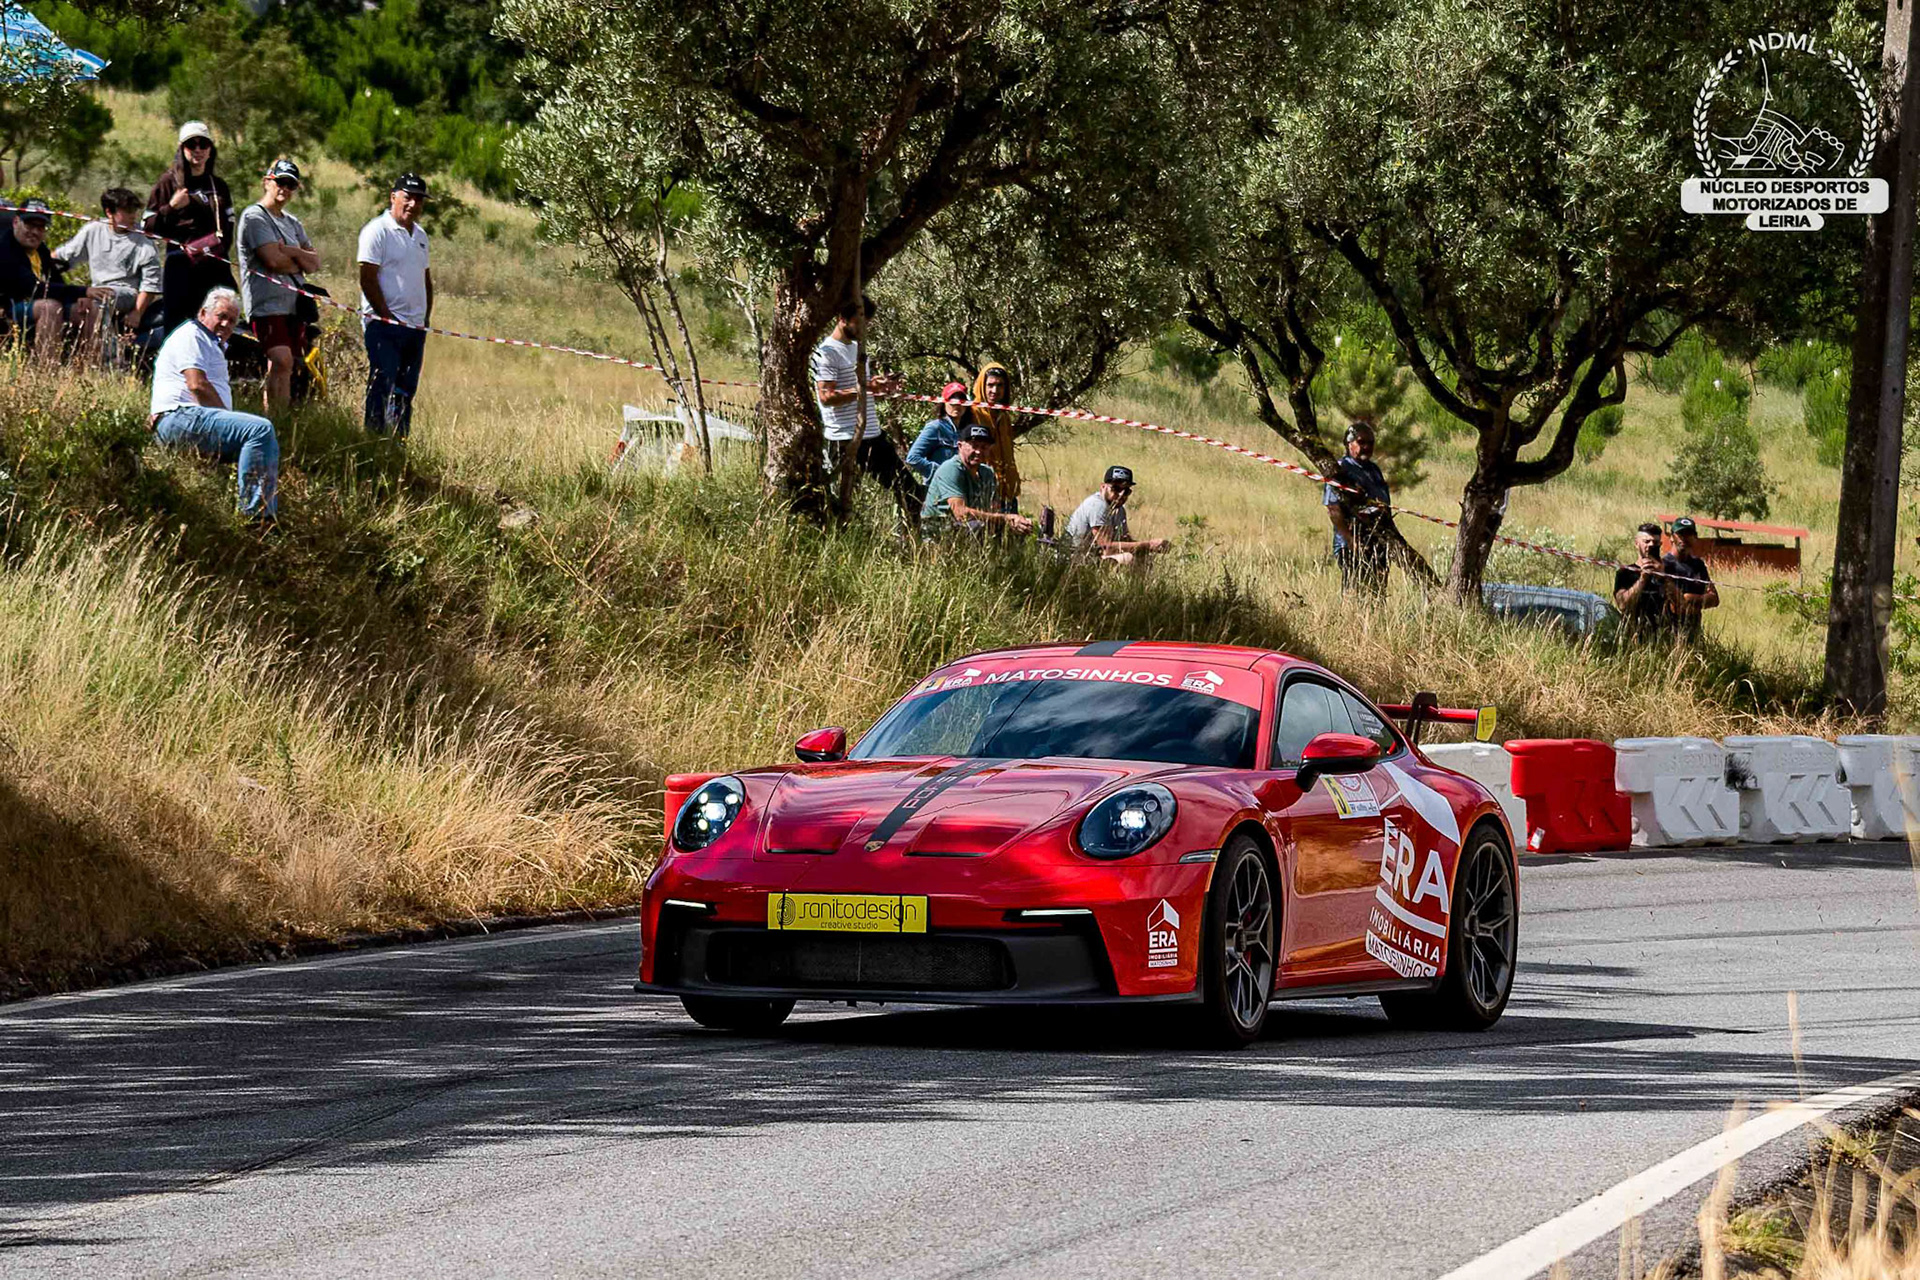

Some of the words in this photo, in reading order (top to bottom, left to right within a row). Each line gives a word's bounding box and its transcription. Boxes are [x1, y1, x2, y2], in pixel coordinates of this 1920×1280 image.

[983, 668, 1173, 686] MATOSINHOS
[1180, 678, 1215, 691] ERA
[1380, 820, 1449, 914] ERA
[820, 921, 852, 930] creative
[853, 921, 878, 930] studio
[1369, 906, 1440, 963] IMOBILIÁRIA
[1149, 930, 1178, 948] ERA
[1368, 933, 1431, 978] MATOSINHOS
